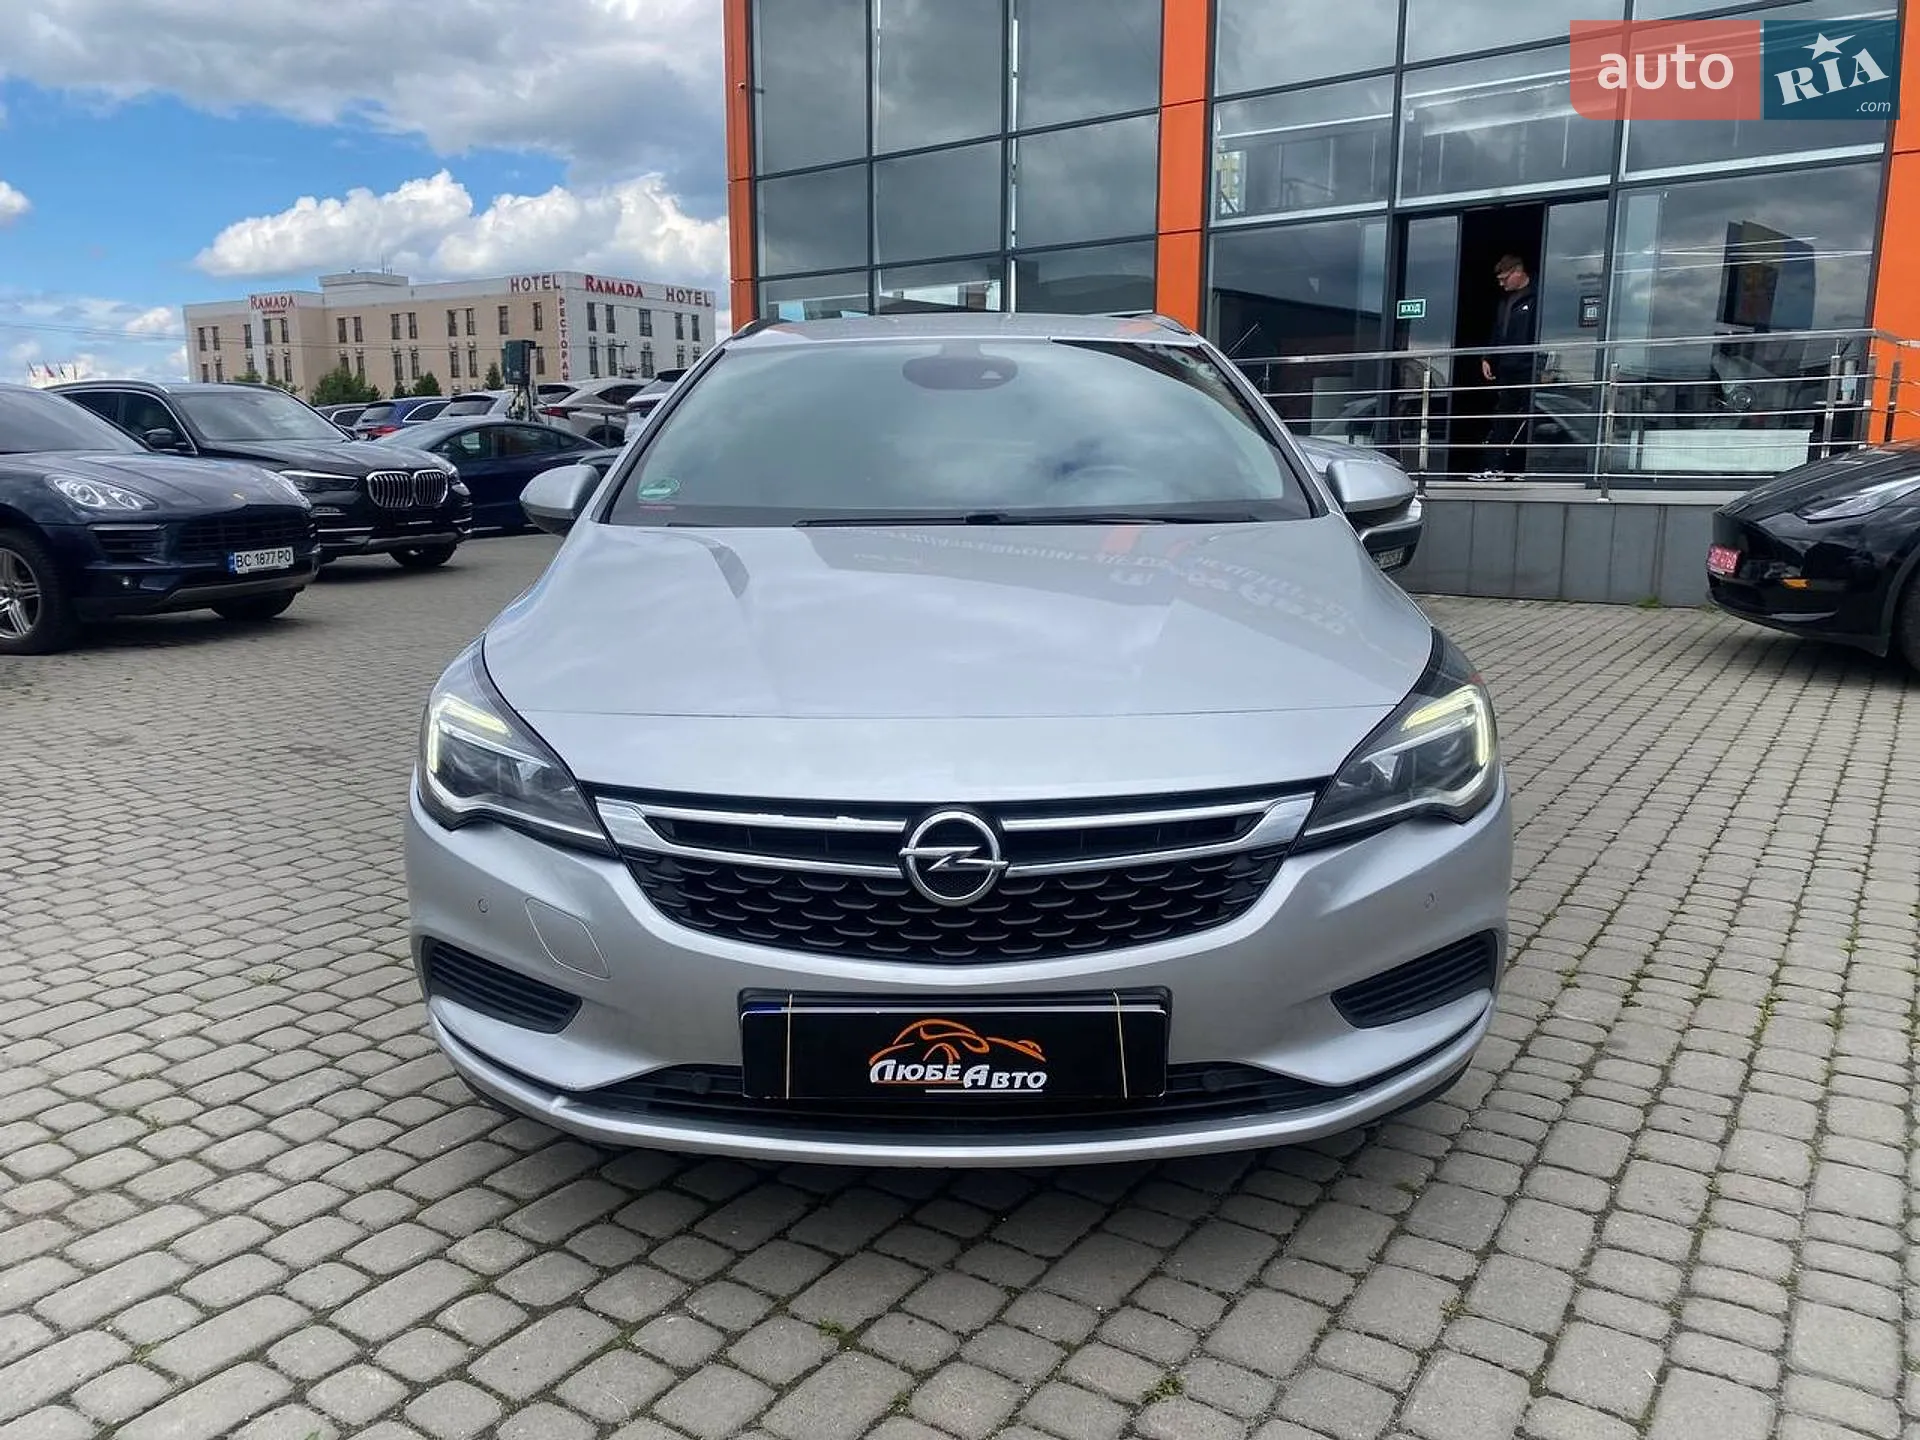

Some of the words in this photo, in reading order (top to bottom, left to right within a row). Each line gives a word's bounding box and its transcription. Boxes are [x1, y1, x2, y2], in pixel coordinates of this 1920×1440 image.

[251, 294, 295, 309] RAMADA
[510, 274, 560, 292] HOTEL
[585, 274, 643, 298] RAMADA
[666, 287, 711, 307] HOTEL
[559, 297, 569, 381] РЕСТОРАН
[235, 554, 251, 567] BC
[255, 550, 276, 565] 1877
